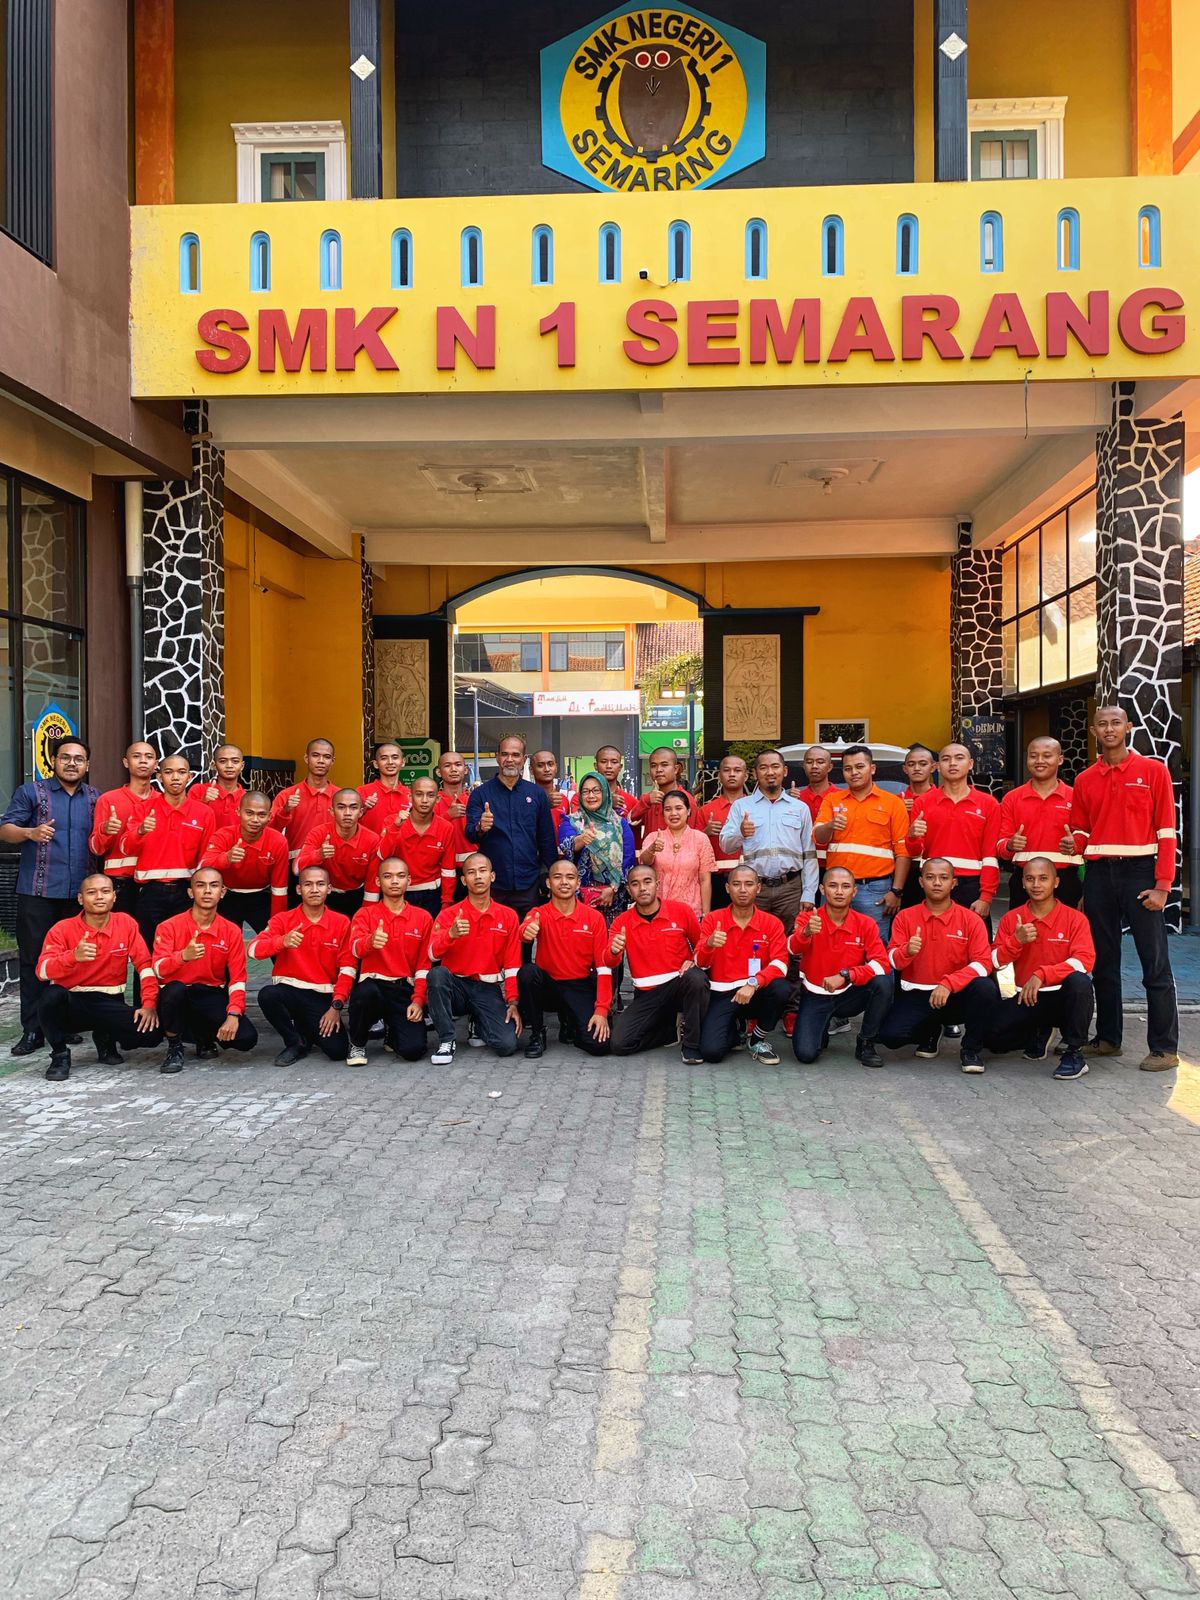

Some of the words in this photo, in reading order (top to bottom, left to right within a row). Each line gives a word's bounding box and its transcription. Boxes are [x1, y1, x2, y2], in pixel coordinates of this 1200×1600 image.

[574, 23, 630, 81] SMK
[629, 12, 722, 61] NEGERI
[710, 54, 734, 74] 1
[572, 128, 732, 192] SEMARANG
[195, 306, 400, 374] SMK
[436, 304, 496, 370] N
[539, 302, 576, 367] 1
[622, 287, 1187, 366] SEMARANG
[49, 715, 67, 729] NEGERI
[405, 750, 430, 764] rab
